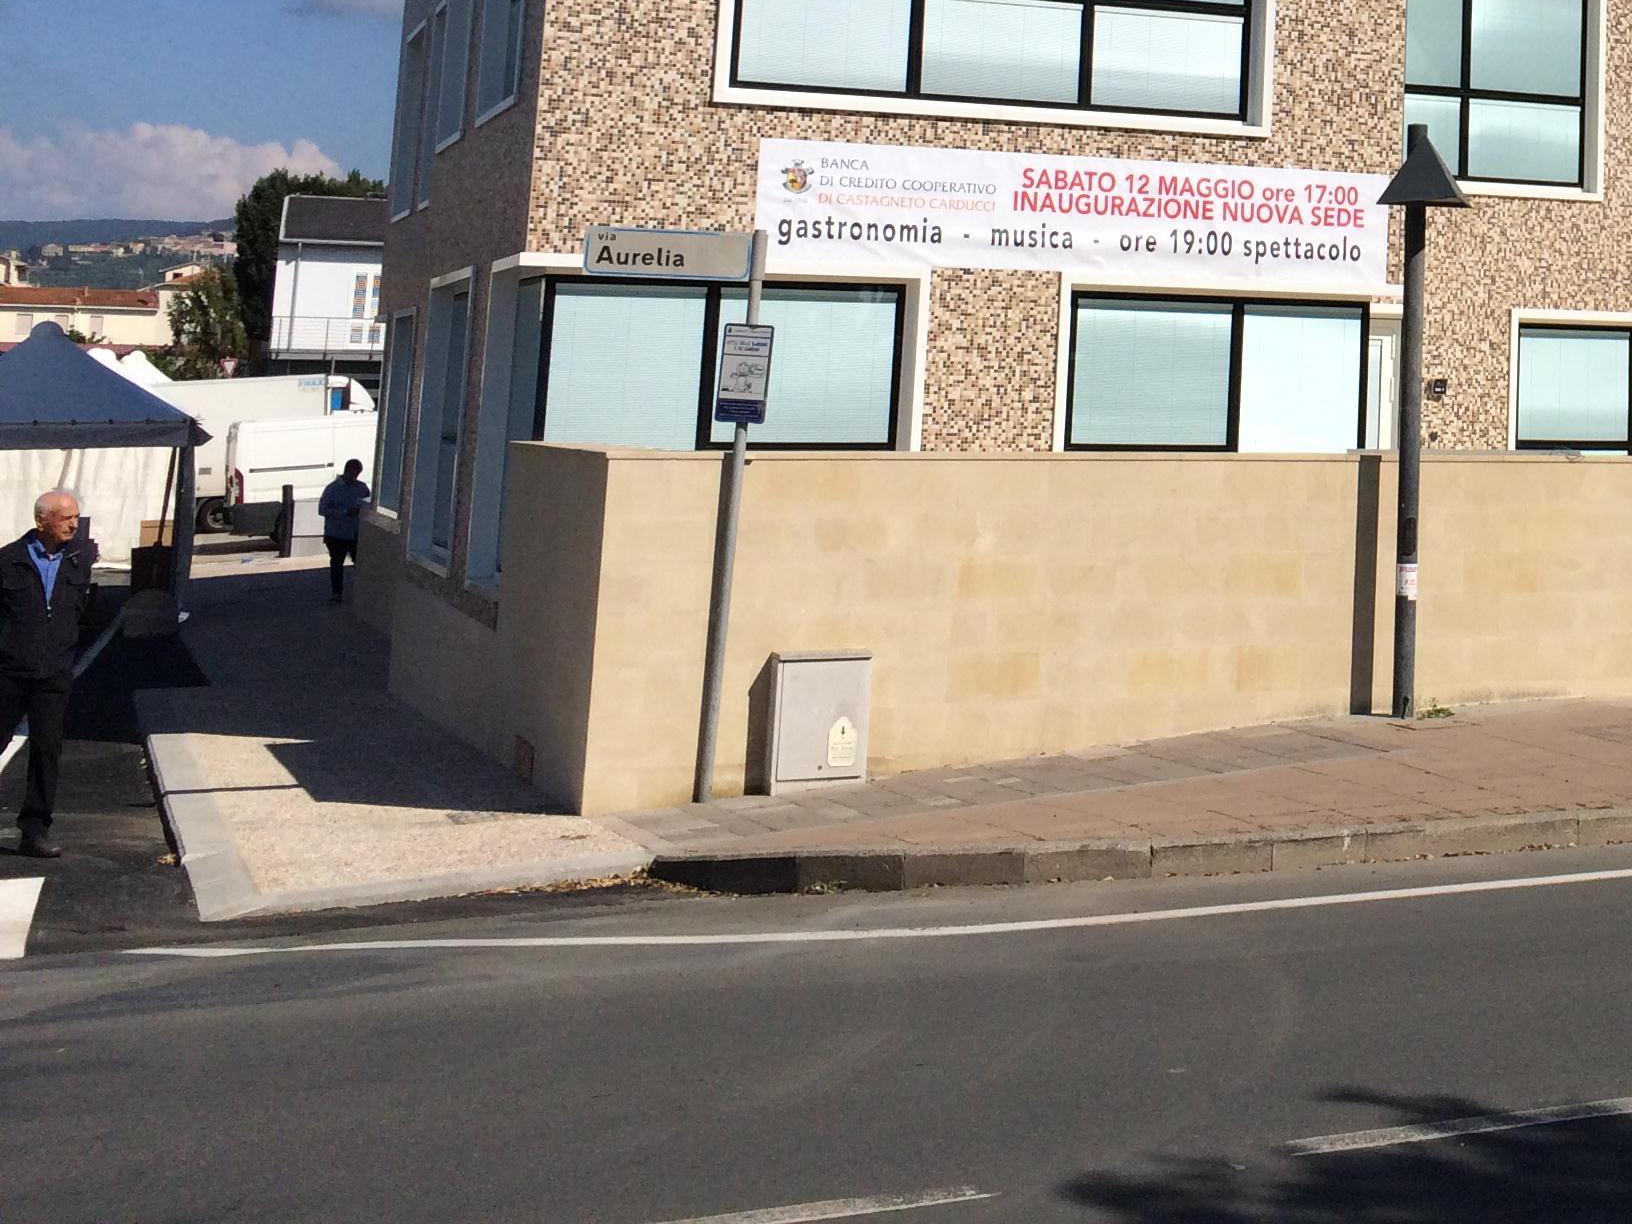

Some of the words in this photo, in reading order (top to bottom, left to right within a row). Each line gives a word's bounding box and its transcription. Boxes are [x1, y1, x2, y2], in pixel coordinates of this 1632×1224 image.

[821, 158, 869, 170] BANCA
[820, 176, 833, 186] DI
[839, 176, 897, 190] CREDITO
[902, 179, 997, 195] COOPERATIVO
[1022, 167, 1116, 193] SABATO
[1125, 174, 1149, 195] 12
[1158, 175, 1255, 201] MAGGIO
[1262, 186, 1296, 203] ore
[1304, 183, 1359, 206] 17:00
[818, 193, 832, 204] DI
[836, 194, 926, 209] CASTAGNETO
[930, 198, 995, 212] CARDUCCI
[1012, 191, 1214, 221] INAUGURAZIONE
[1222, 201, 1303, 225] NUOVA
[1311, 207, 1365, 229] SEDE
[598, 231, 617, 241] via
[777, 216, 942, 246] gastronomia
[990, 223, 1073, 249] musica
[1119, 235, 1157, 253] ore
[1170, 229, 1233, 256] 19:00
[1243, 236, 1362, 264] spettacolo
[595, 245, 685, 267] Aurelia
